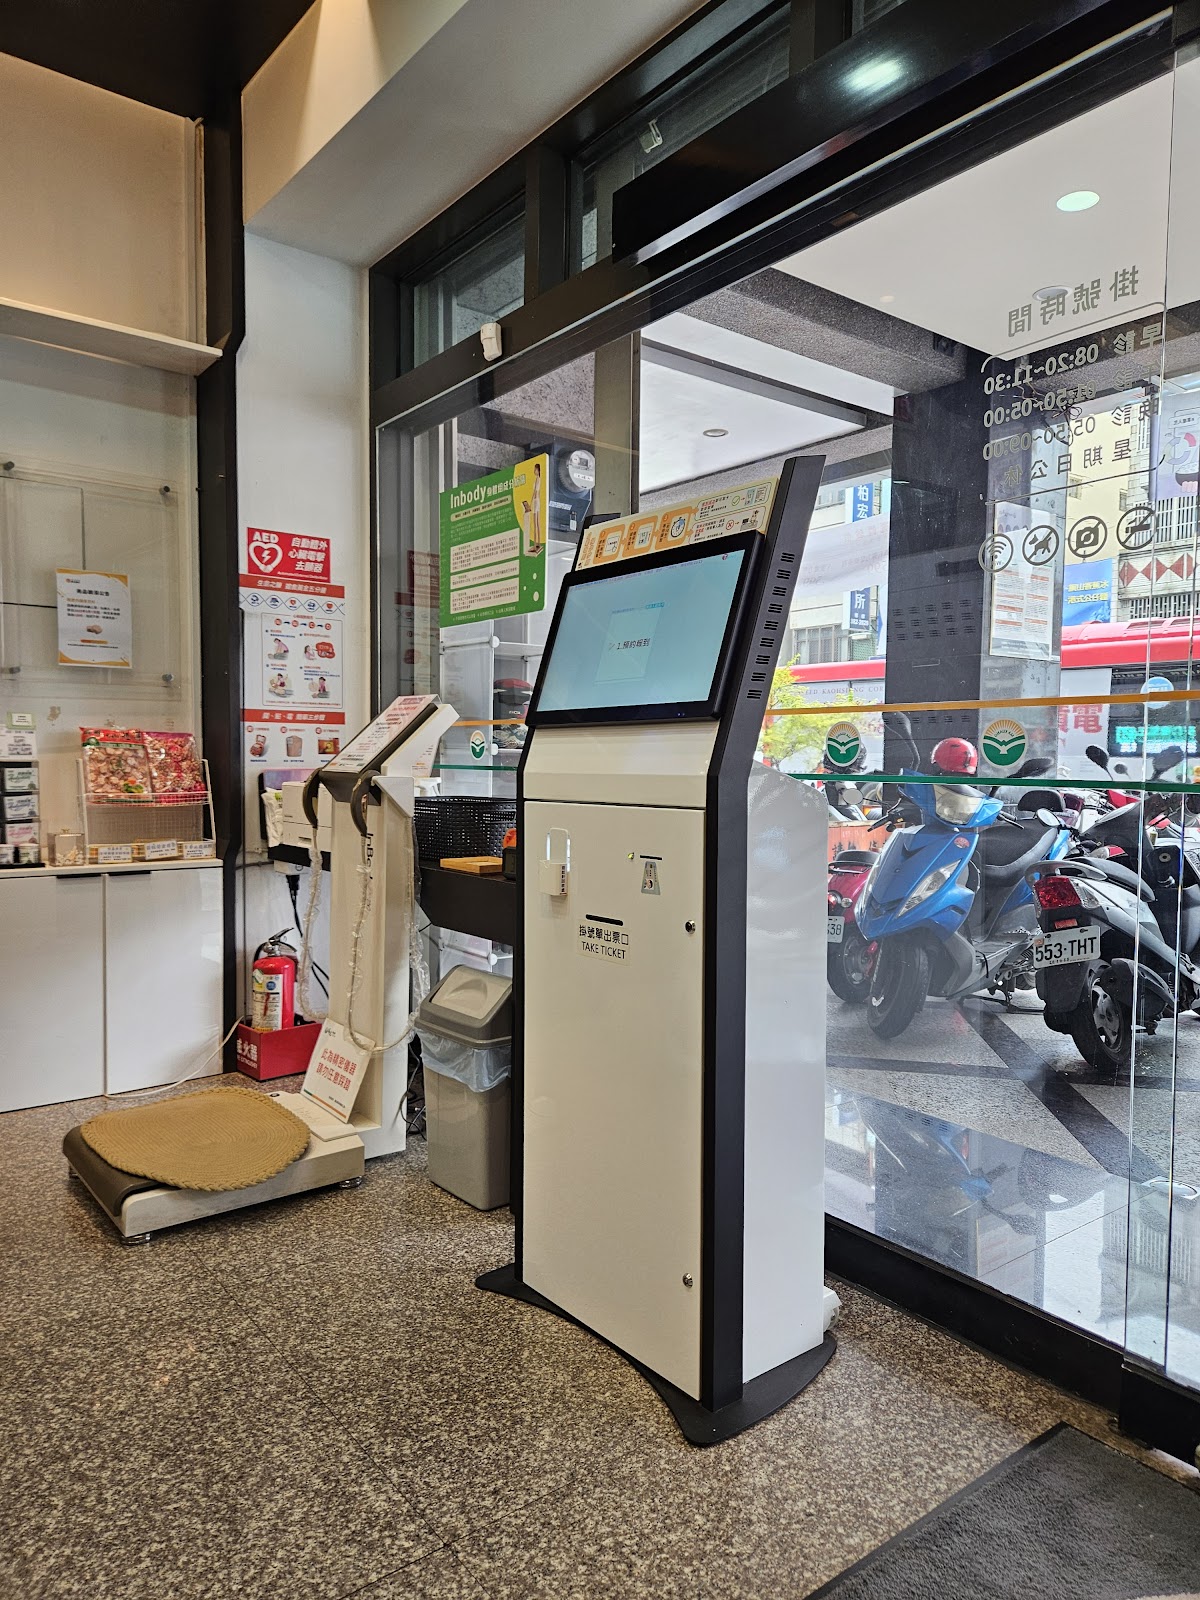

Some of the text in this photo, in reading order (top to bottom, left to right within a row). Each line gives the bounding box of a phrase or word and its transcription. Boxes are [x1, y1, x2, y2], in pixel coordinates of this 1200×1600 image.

[450, 484, 486, 509] Inbody
[253, 531, 279, 543] AED
[821, 687, 864, 695] KAOHSING
[578, 924, 629, 946] 掛號單出票口
[581, 941, 626, 960] TAKE TICKET
